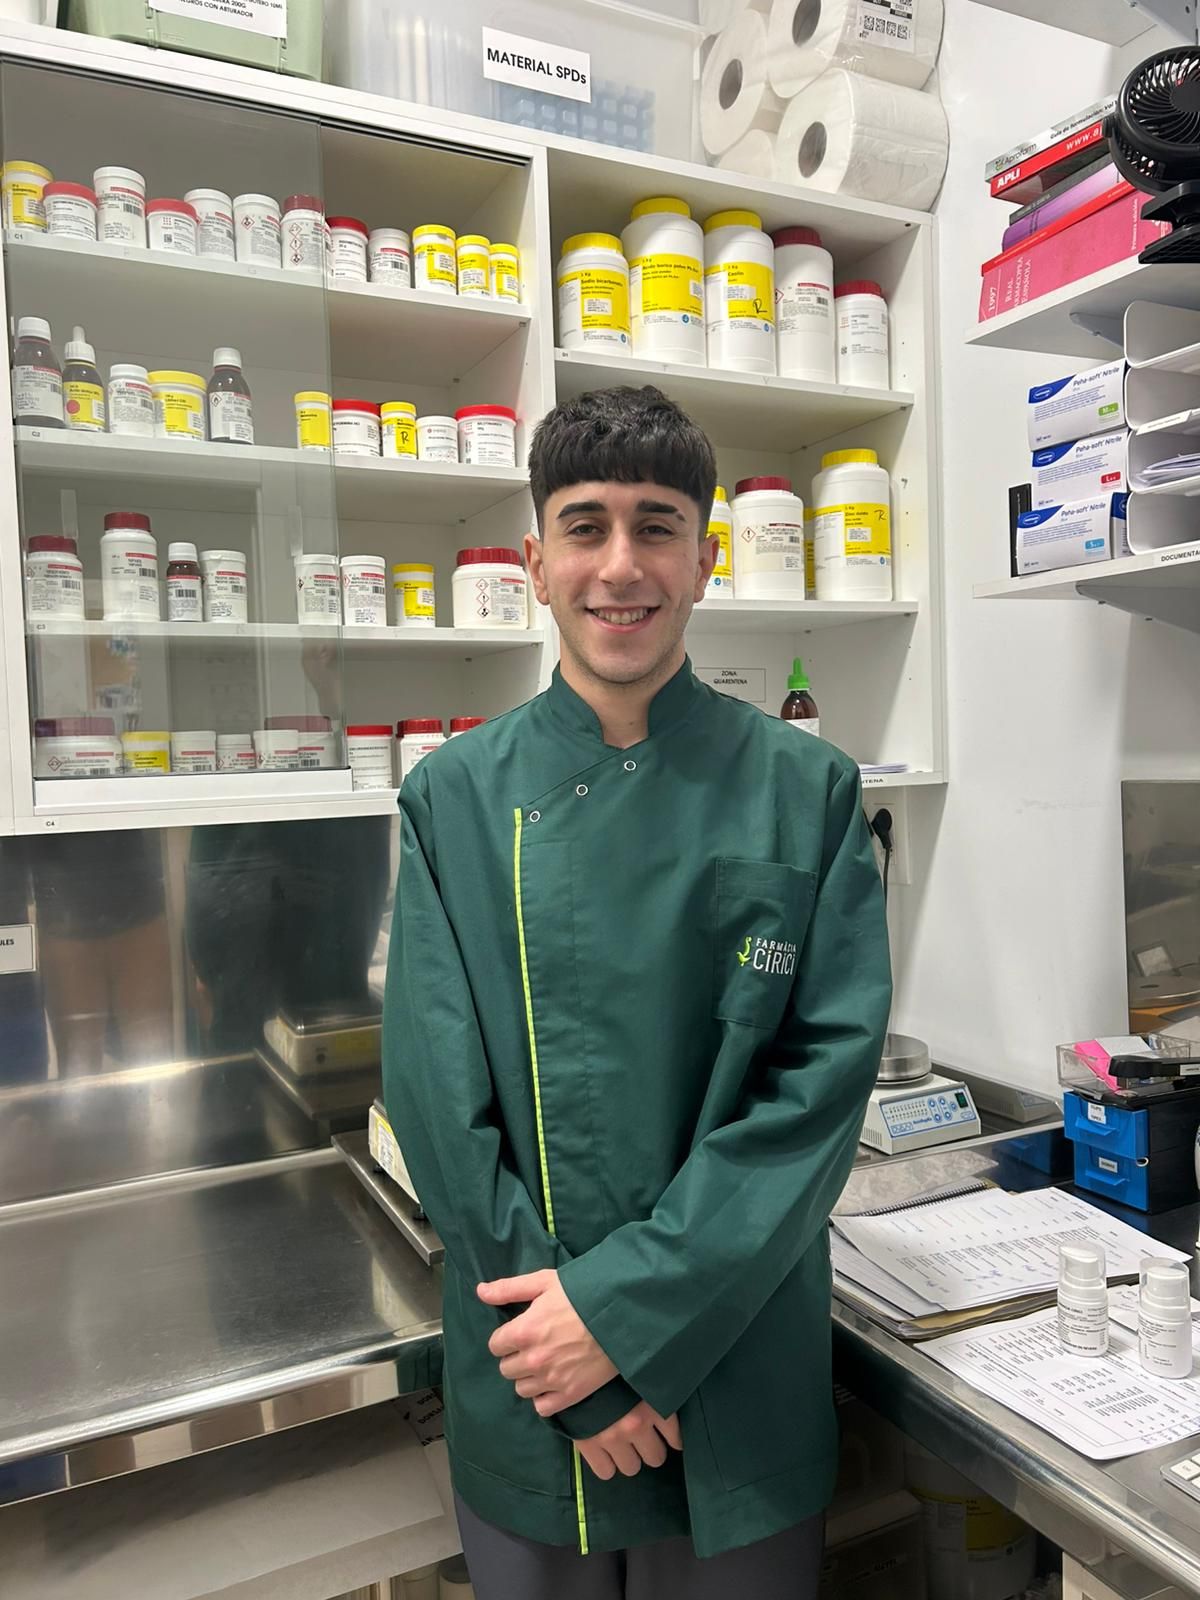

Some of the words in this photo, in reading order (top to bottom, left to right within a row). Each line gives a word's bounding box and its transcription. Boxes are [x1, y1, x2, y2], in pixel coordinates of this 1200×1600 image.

[204, 2, 218, 10] CON
[487, 48, 553, 76] MATERIAL
[555, 65, 587, 84] SPDs
[997, 167, 1021, 188] APLI
[1101, 367, 1120, 378] Nitrile
[1104, 436, 1122, 445] Nitrile
[1089, 502, 1106, 511] Nitrile
